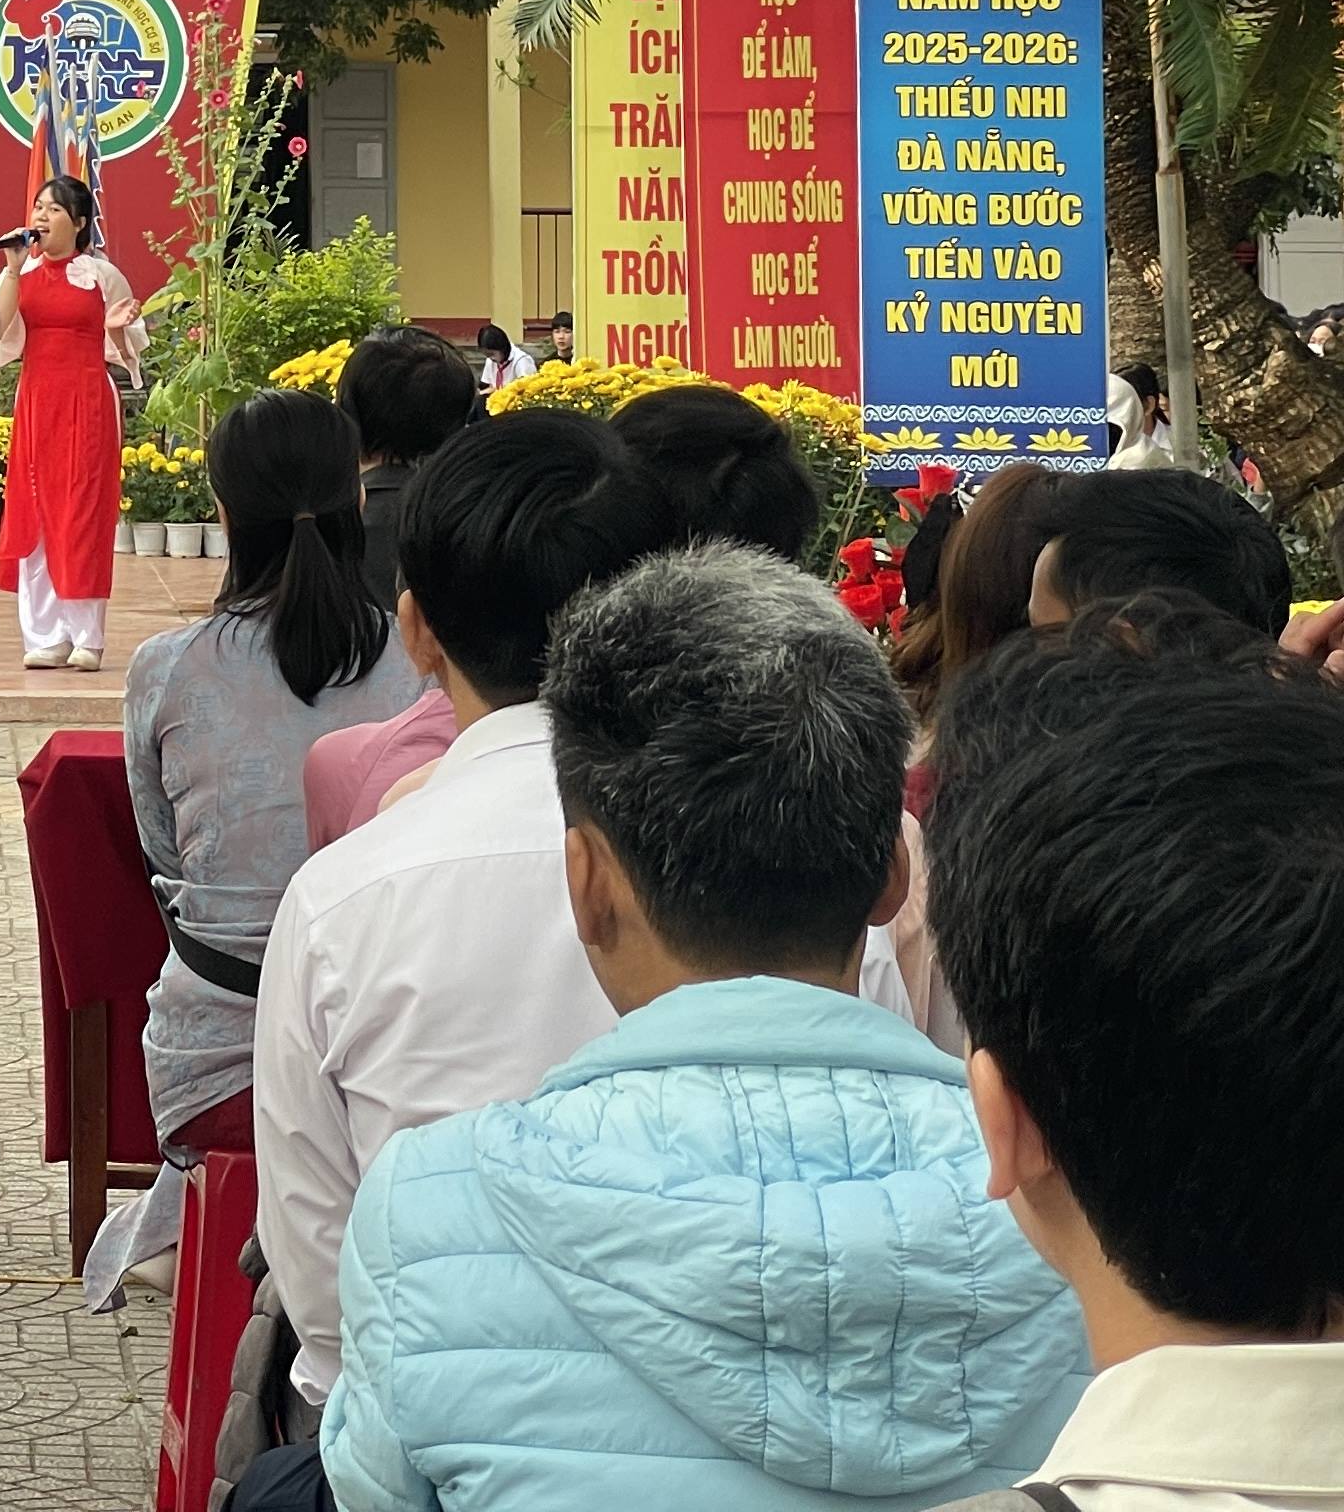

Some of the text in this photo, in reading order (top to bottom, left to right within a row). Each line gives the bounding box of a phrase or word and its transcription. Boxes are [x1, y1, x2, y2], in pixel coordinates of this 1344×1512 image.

[743, 19, 817, 83] ĐỂ LÀM,
[884, 32, 1078, 65] 2025-2026:
[118, 111, 134, 127] AN
[896, 78, 1066, 121] THIẾU NHI
[749, 91, 815, 159] HỌC ĐỂ
[897, 131, 1065, 176] ĐÀ NẴNG,
[724, 166, 843, 223] CHUNG SỐNG
[883, 186, 1082, 227] VỮNG BƯỚC
[752, 236, 818, 304] HỌC ĐỂ
[905, 238, 1062, 280] TIẾN VÀO
[886, 293, 1082, 334] KỶ NGUYÊN
[734, 315, 841, 368] LÀM NGƯỜI.
[950, 346, 1020, 389] MỚI
